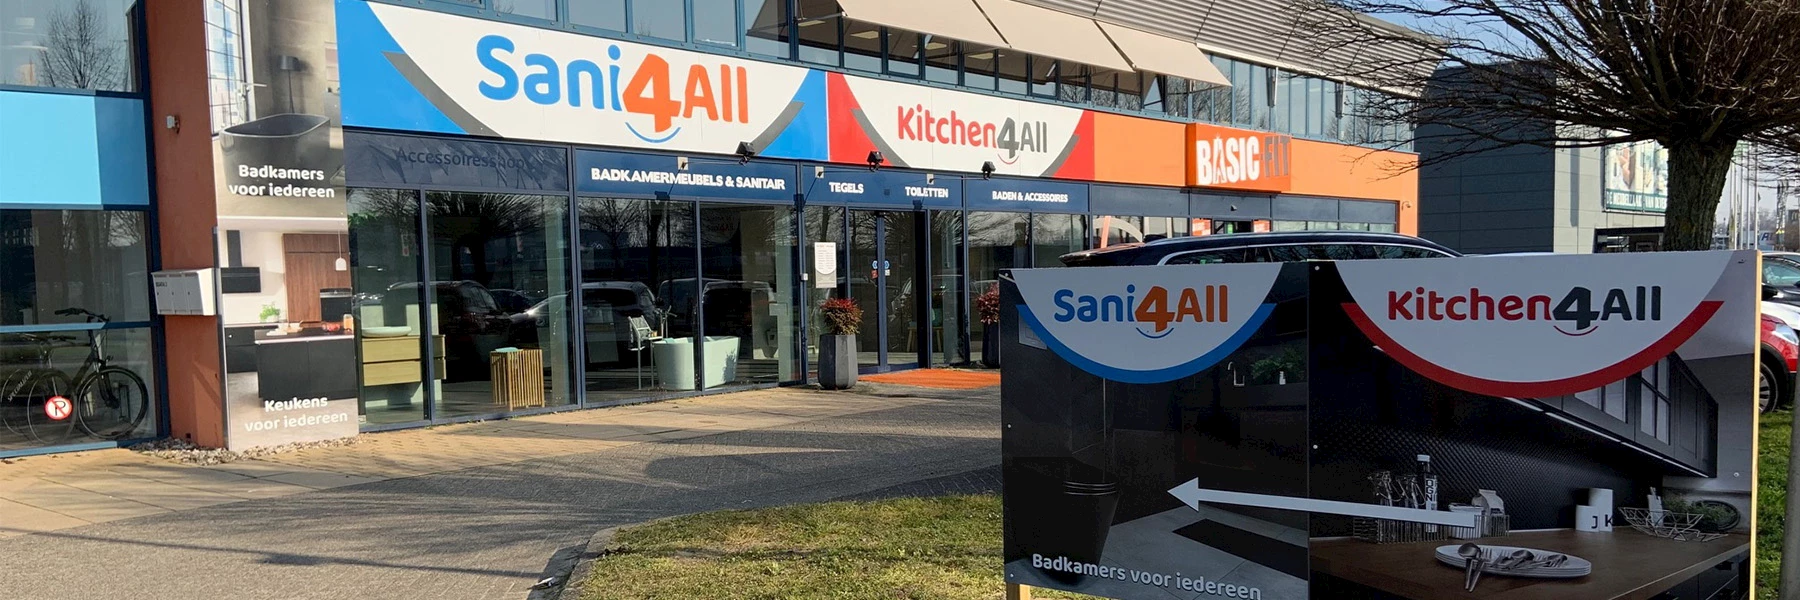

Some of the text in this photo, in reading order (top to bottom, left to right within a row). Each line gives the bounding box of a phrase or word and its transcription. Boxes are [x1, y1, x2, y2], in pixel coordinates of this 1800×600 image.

[476, 34, 749, 133] Sani4All
[898, 104, 1048, 159] Kitchen4All
[1196, 134, 1292, 186] BASIC-FIT
[238, 164, 325, 181] Badkamers
[590, 167, 786, 190] BADKAMERMEUBELS & SANITAIR
[228, 182, 335, 198] voor iedereen
[829, 181, 864, 194] TEGELS
[904, 186, 949, 199] TOILETTEN
[992, 190, 1068, 203] BADEN & ACCESSOIRES
[1053, 284, 1228, 333] Sani4All
[1388, 286, 1661, 331] Kitchen4All
[264, 396, 329, 413] Keukens
[244, 412, 348, 432] voor iedereen
[1032, 553, 1262, 600] Badkamers voor iedereen
